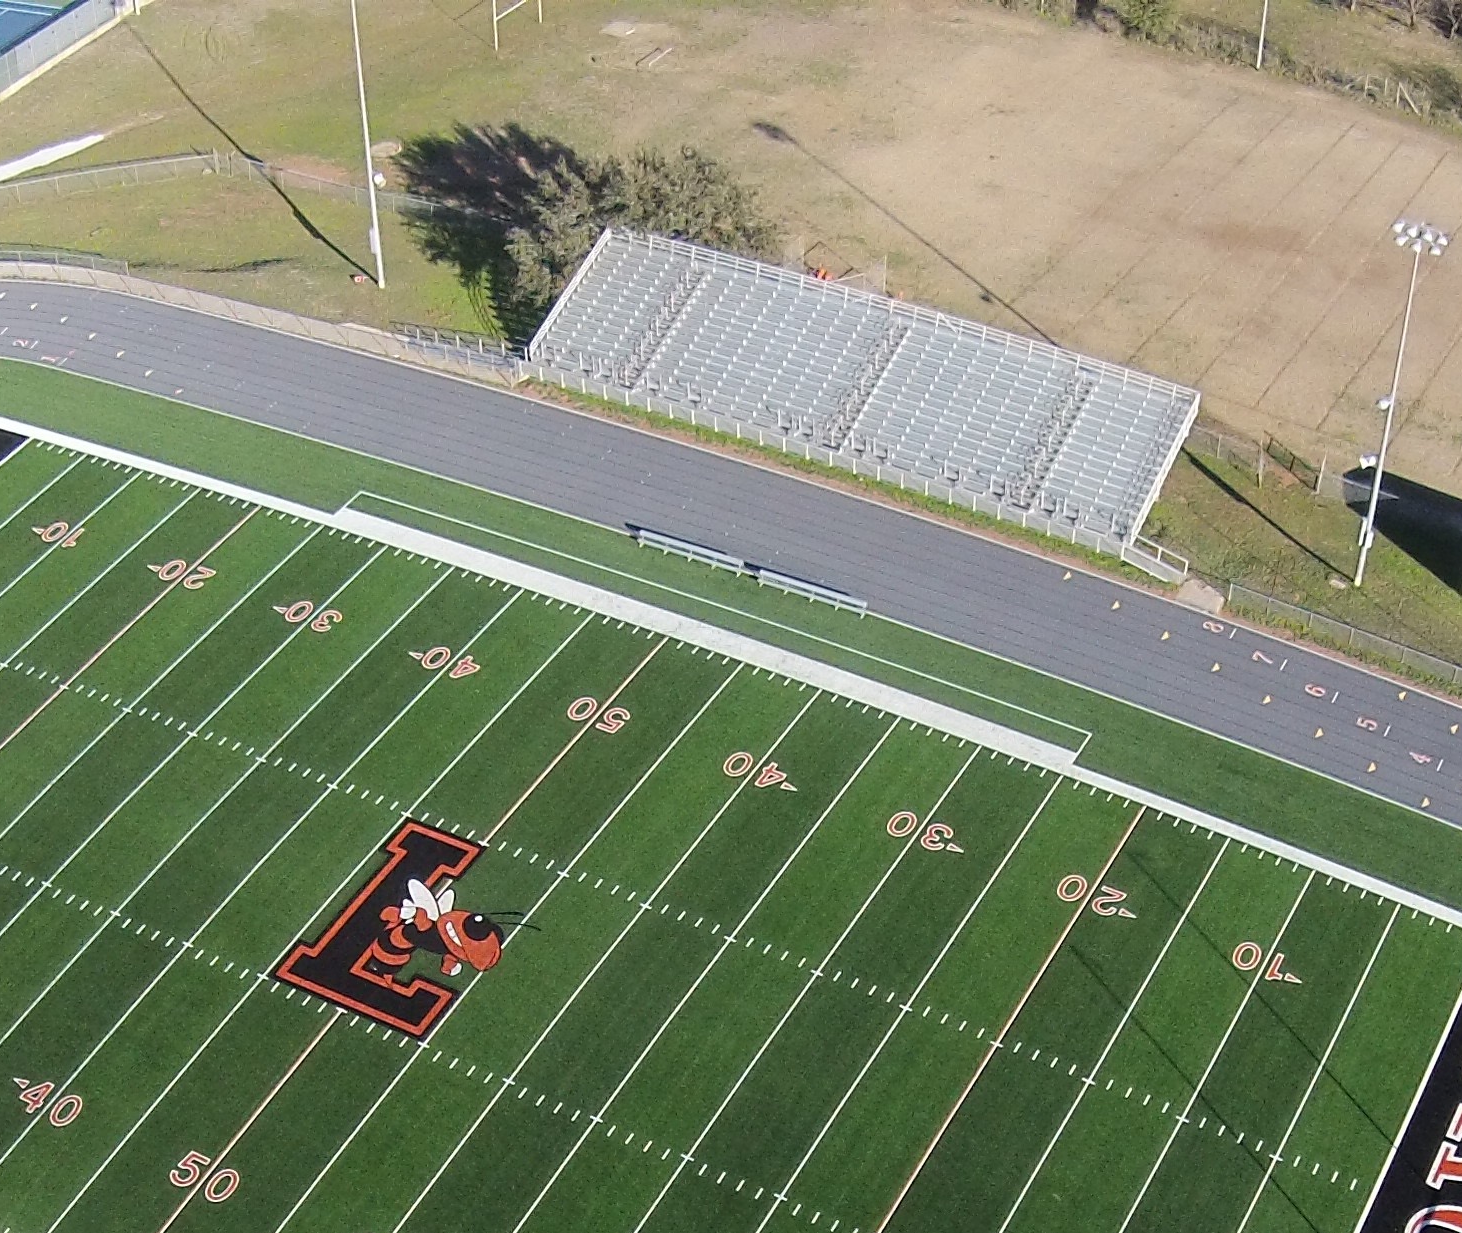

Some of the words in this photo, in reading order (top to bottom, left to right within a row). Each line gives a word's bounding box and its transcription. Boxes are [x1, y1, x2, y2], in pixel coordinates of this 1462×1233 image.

[42, 520, 86, 550] 10
[159, 558, 218, 589] 20
[284, 601, 343, 633] 30
[1202, 621, 1225, 634] 8
[422, 647, 481, 680] 40
[1251, 650, 1273, 665] 7
[1304, 683, 1327, 698] 6
[567, 696, 631, 735] 50
[1356, 716, 1379, 732] 5
[723, 751, 785, 789] 40
[1408, 752, 1431, 765] 4
[886, 812, 953, 851] 30
[1056, 875, 1127, 917] 20
[1232, 941, 1285, 982] 10
[18, 1081, 83, 1128] 40
[169, 1151, 241, 1204] 50
